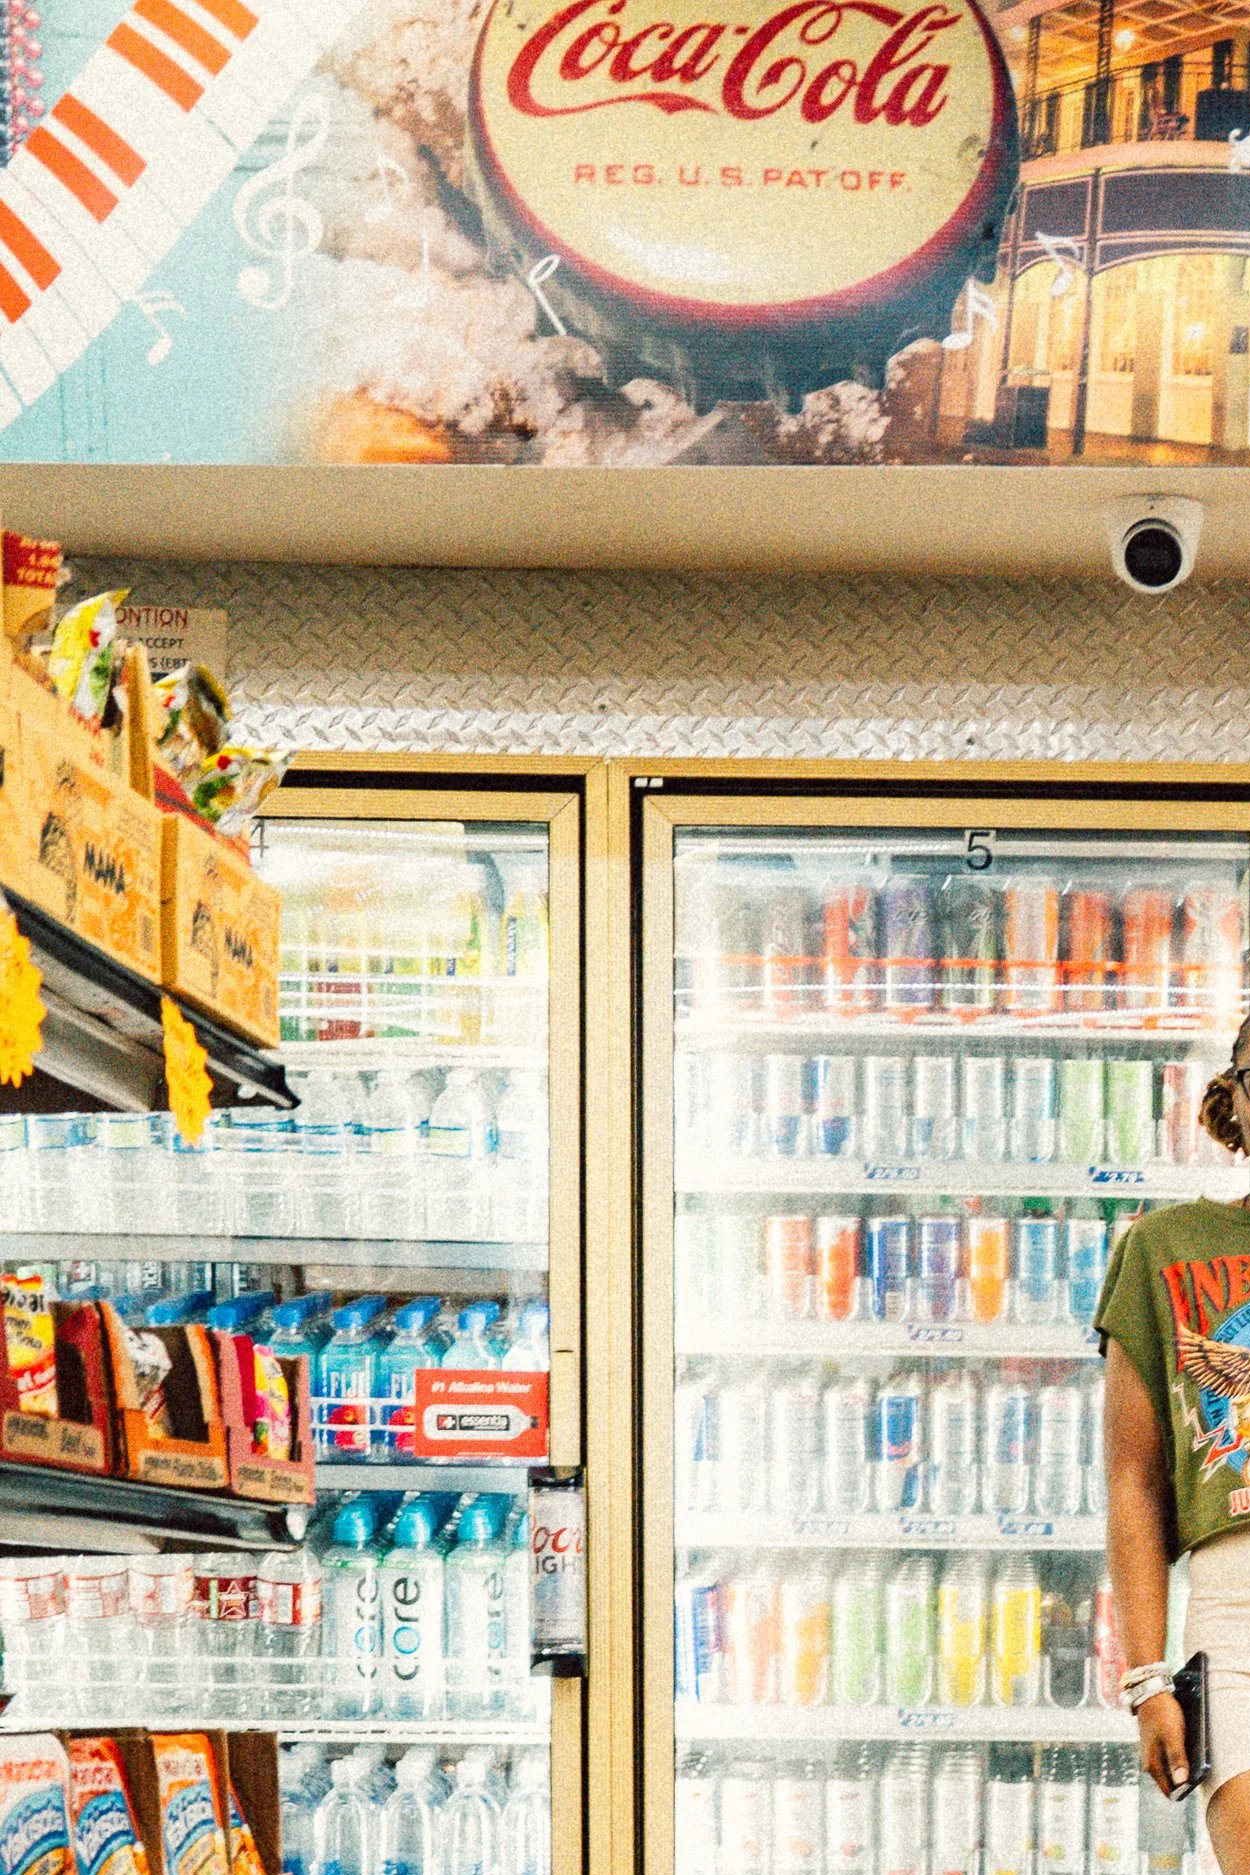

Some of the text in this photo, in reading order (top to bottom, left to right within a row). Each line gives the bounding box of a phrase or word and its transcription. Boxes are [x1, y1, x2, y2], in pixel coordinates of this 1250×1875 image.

[506, 0, 962, 128] Coca-Cola
[573, 163, 664, 185] REG.
[138, 637, 184, 649] CCEPT
[963, 831, 995, 871] 5
[392, 1576, 421, 1682] core
